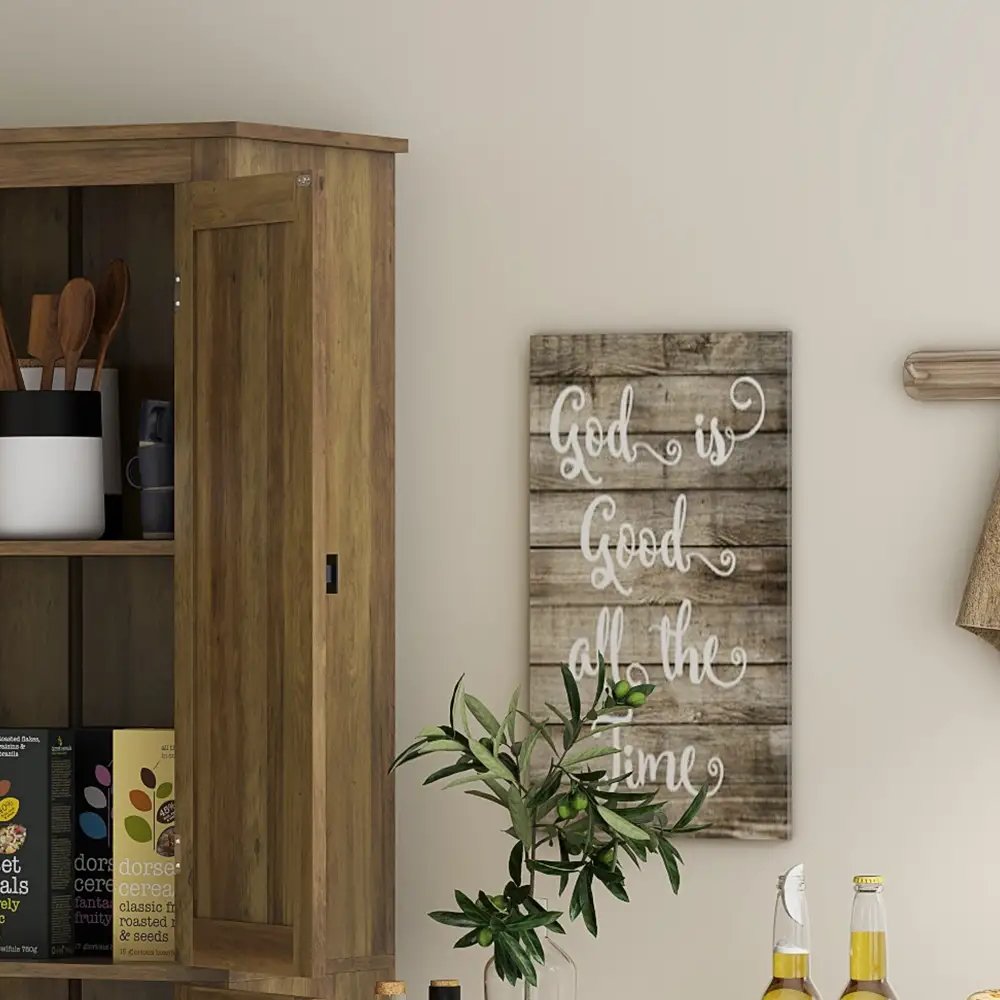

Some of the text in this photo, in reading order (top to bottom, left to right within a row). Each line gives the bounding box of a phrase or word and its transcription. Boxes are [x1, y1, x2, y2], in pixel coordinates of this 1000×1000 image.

[549, 376, 766, 485] God is
[579, 493, 737, 596] Good
[568, 599, 748, 692] all the
[591, 709, 724, 798] Time
[119, 882, 175, 897] cerea
[119, 901, 162, 913] classic
[119, 930, 168, 942] & seeds
[120, 916, 167, 927] roasted
